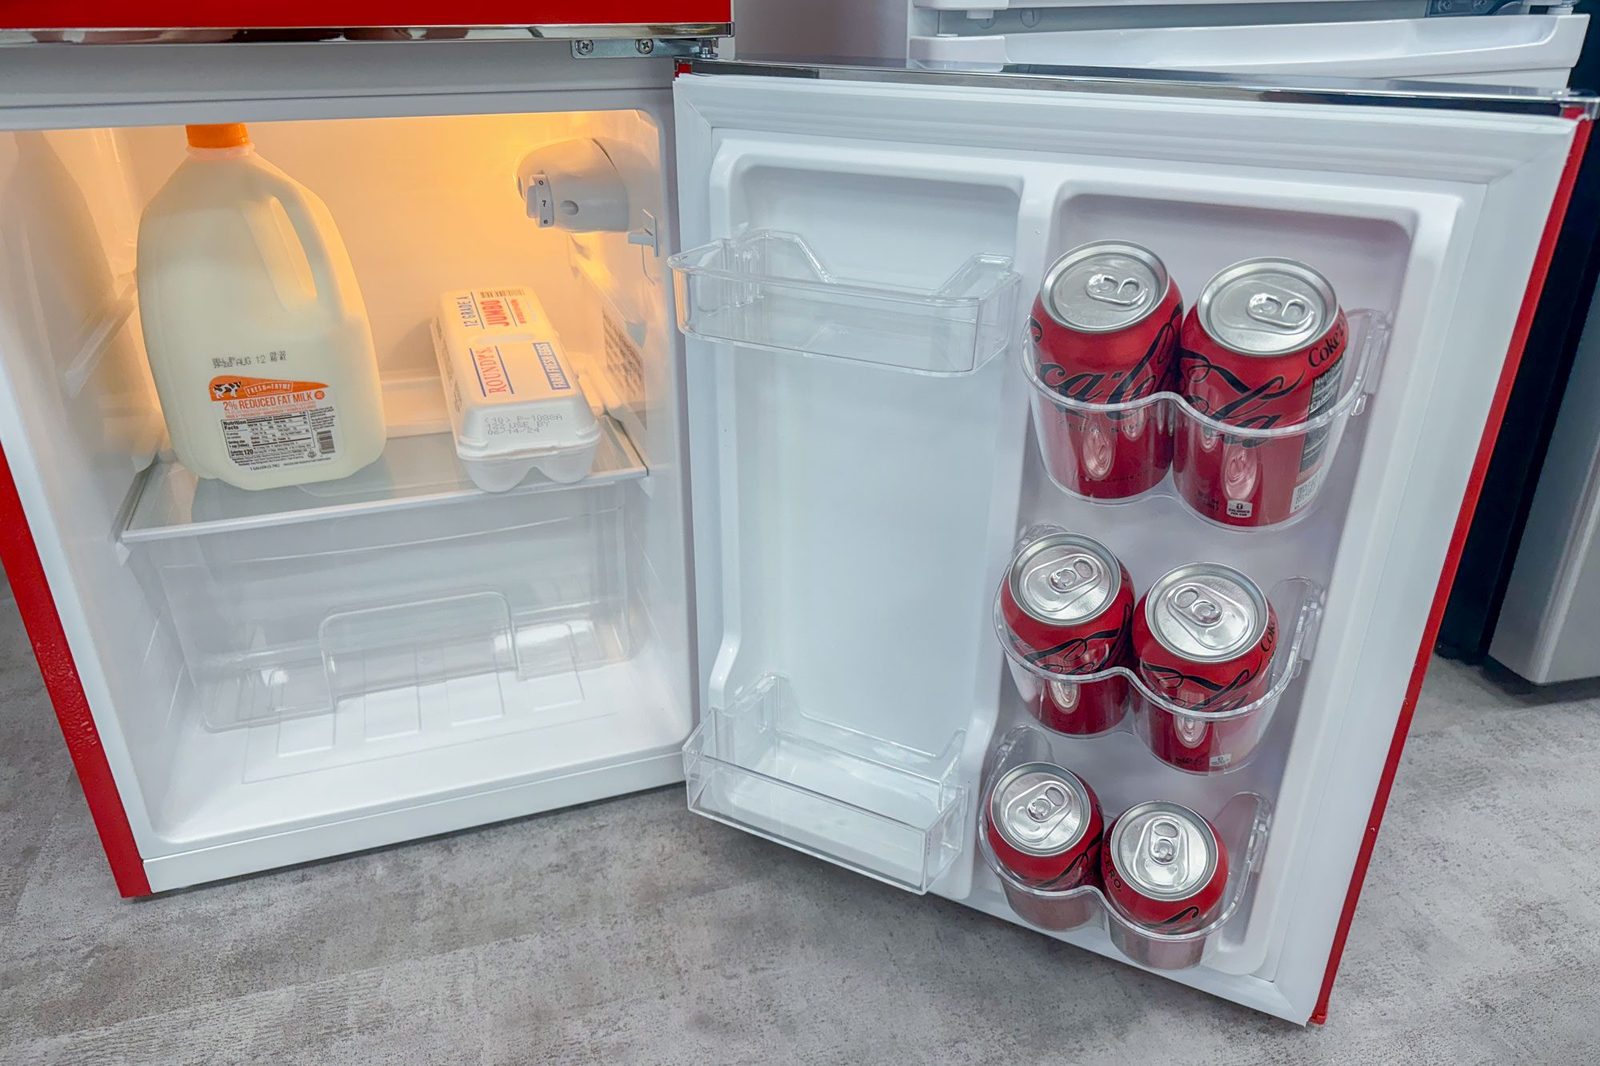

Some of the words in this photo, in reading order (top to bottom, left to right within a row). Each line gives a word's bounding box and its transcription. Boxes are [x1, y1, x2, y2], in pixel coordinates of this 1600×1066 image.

[541, 199, 547, 207] 7
[480, 300, 510, 327] JUMBO
[236, 356, 252, 366] AUG
[256, 354, 266, 364] 12
[1308, 332, 1341, 369] Coke
[223, 401, 238, 411] 2%
[239, 395, 276, 409] REDUCED
[277, 394, 292, 405] FAT
[293, 391, 314, 402] MILK
